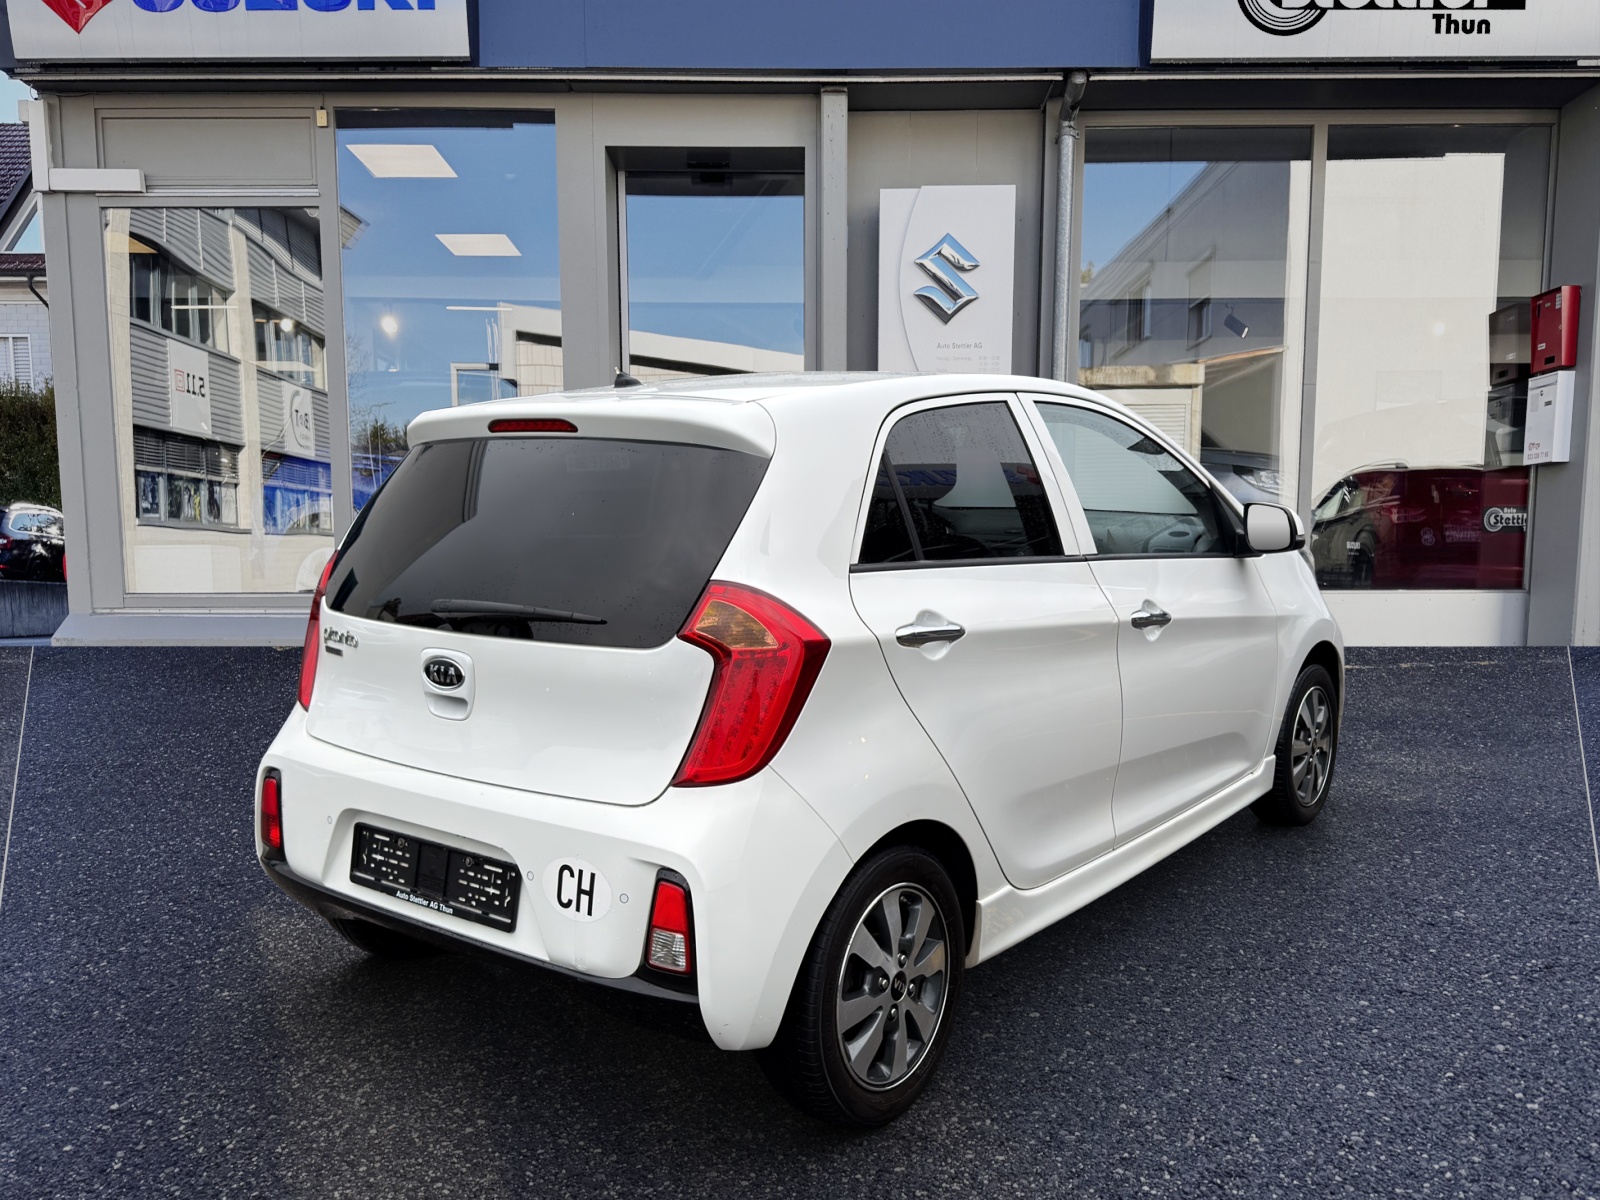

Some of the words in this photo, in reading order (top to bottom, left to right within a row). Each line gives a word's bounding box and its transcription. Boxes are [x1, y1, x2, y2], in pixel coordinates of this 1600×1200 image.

[1432, 13, 1490, 34] Thun
[1493, 514, 1527, 525] Stettl
[429, 664, 458, 685] KIA
[556, 863, 596, 916] CH
[396, 890, 409, 900] Auto
[409, 894, 429, 906] Stettler
[429, 901, 439, 910] AG
[439, 903, 454, 914] Thun
